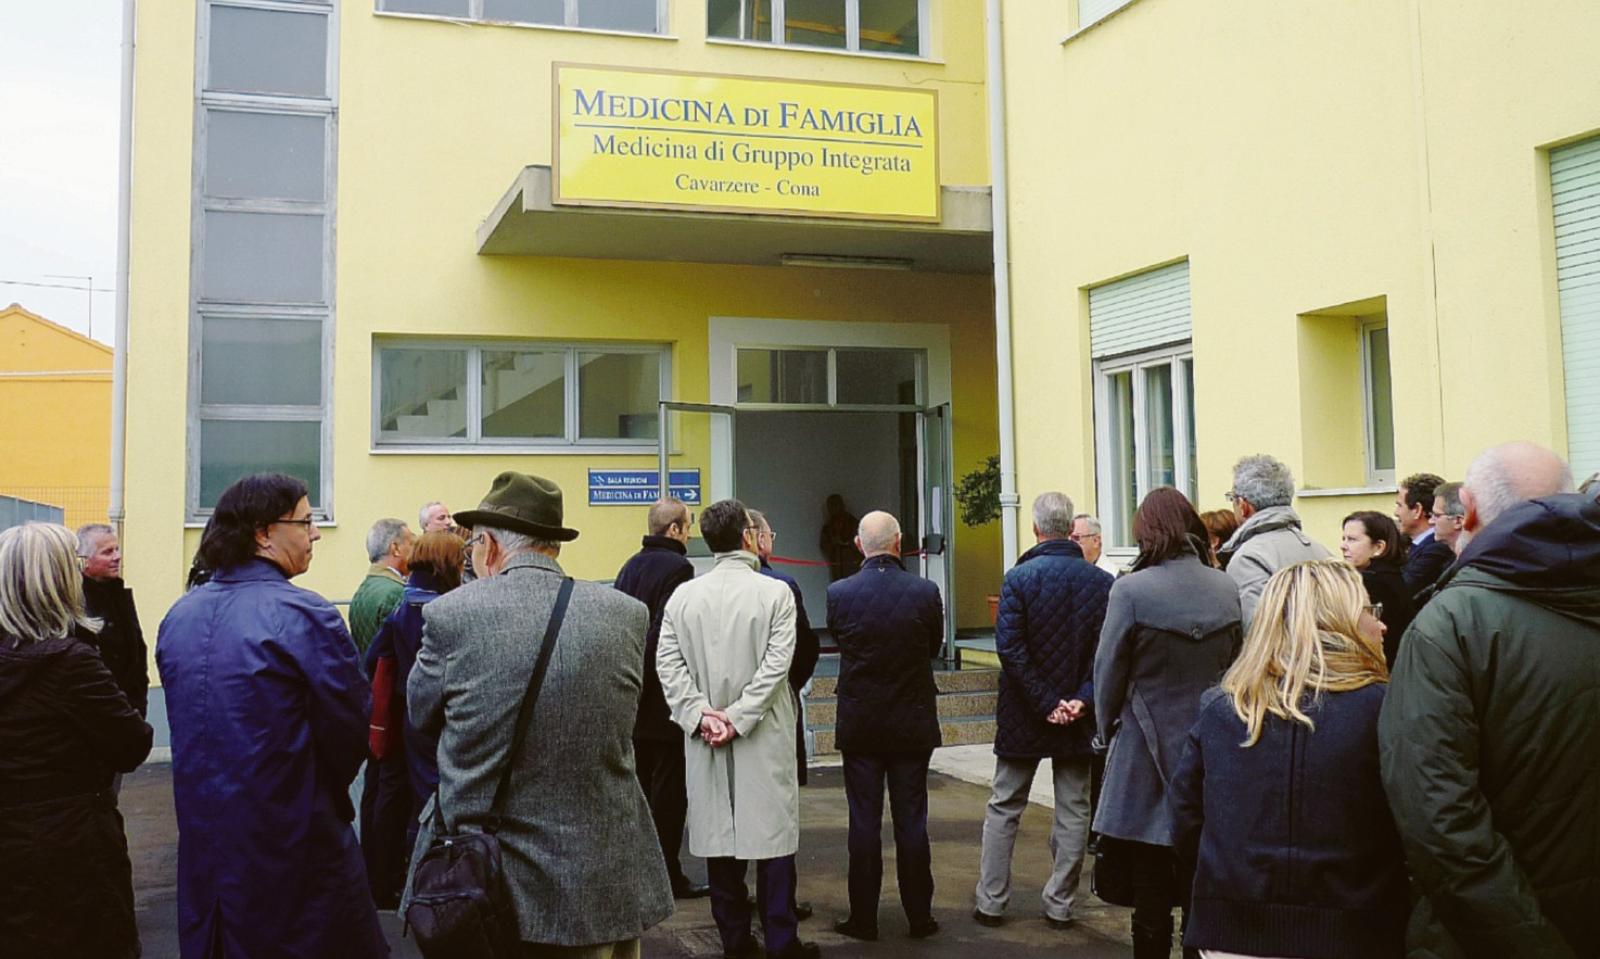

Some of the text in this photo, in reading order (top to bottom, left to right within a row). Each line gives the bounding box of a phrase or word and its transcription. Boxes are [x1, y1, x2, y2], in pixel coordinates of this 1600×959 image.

[573, 88, 923, 138] MEDICINA DI FAMIGLIA
[593, 134, 912, 175] Medicina di Gruppo Integrata
[675, 174, 759, 195] Cavarzere
[777, 179, 820, 197] Cona
[593, 489, 633, 500] MEDICINA
[643, 489, 681, 500] FAMLIA
